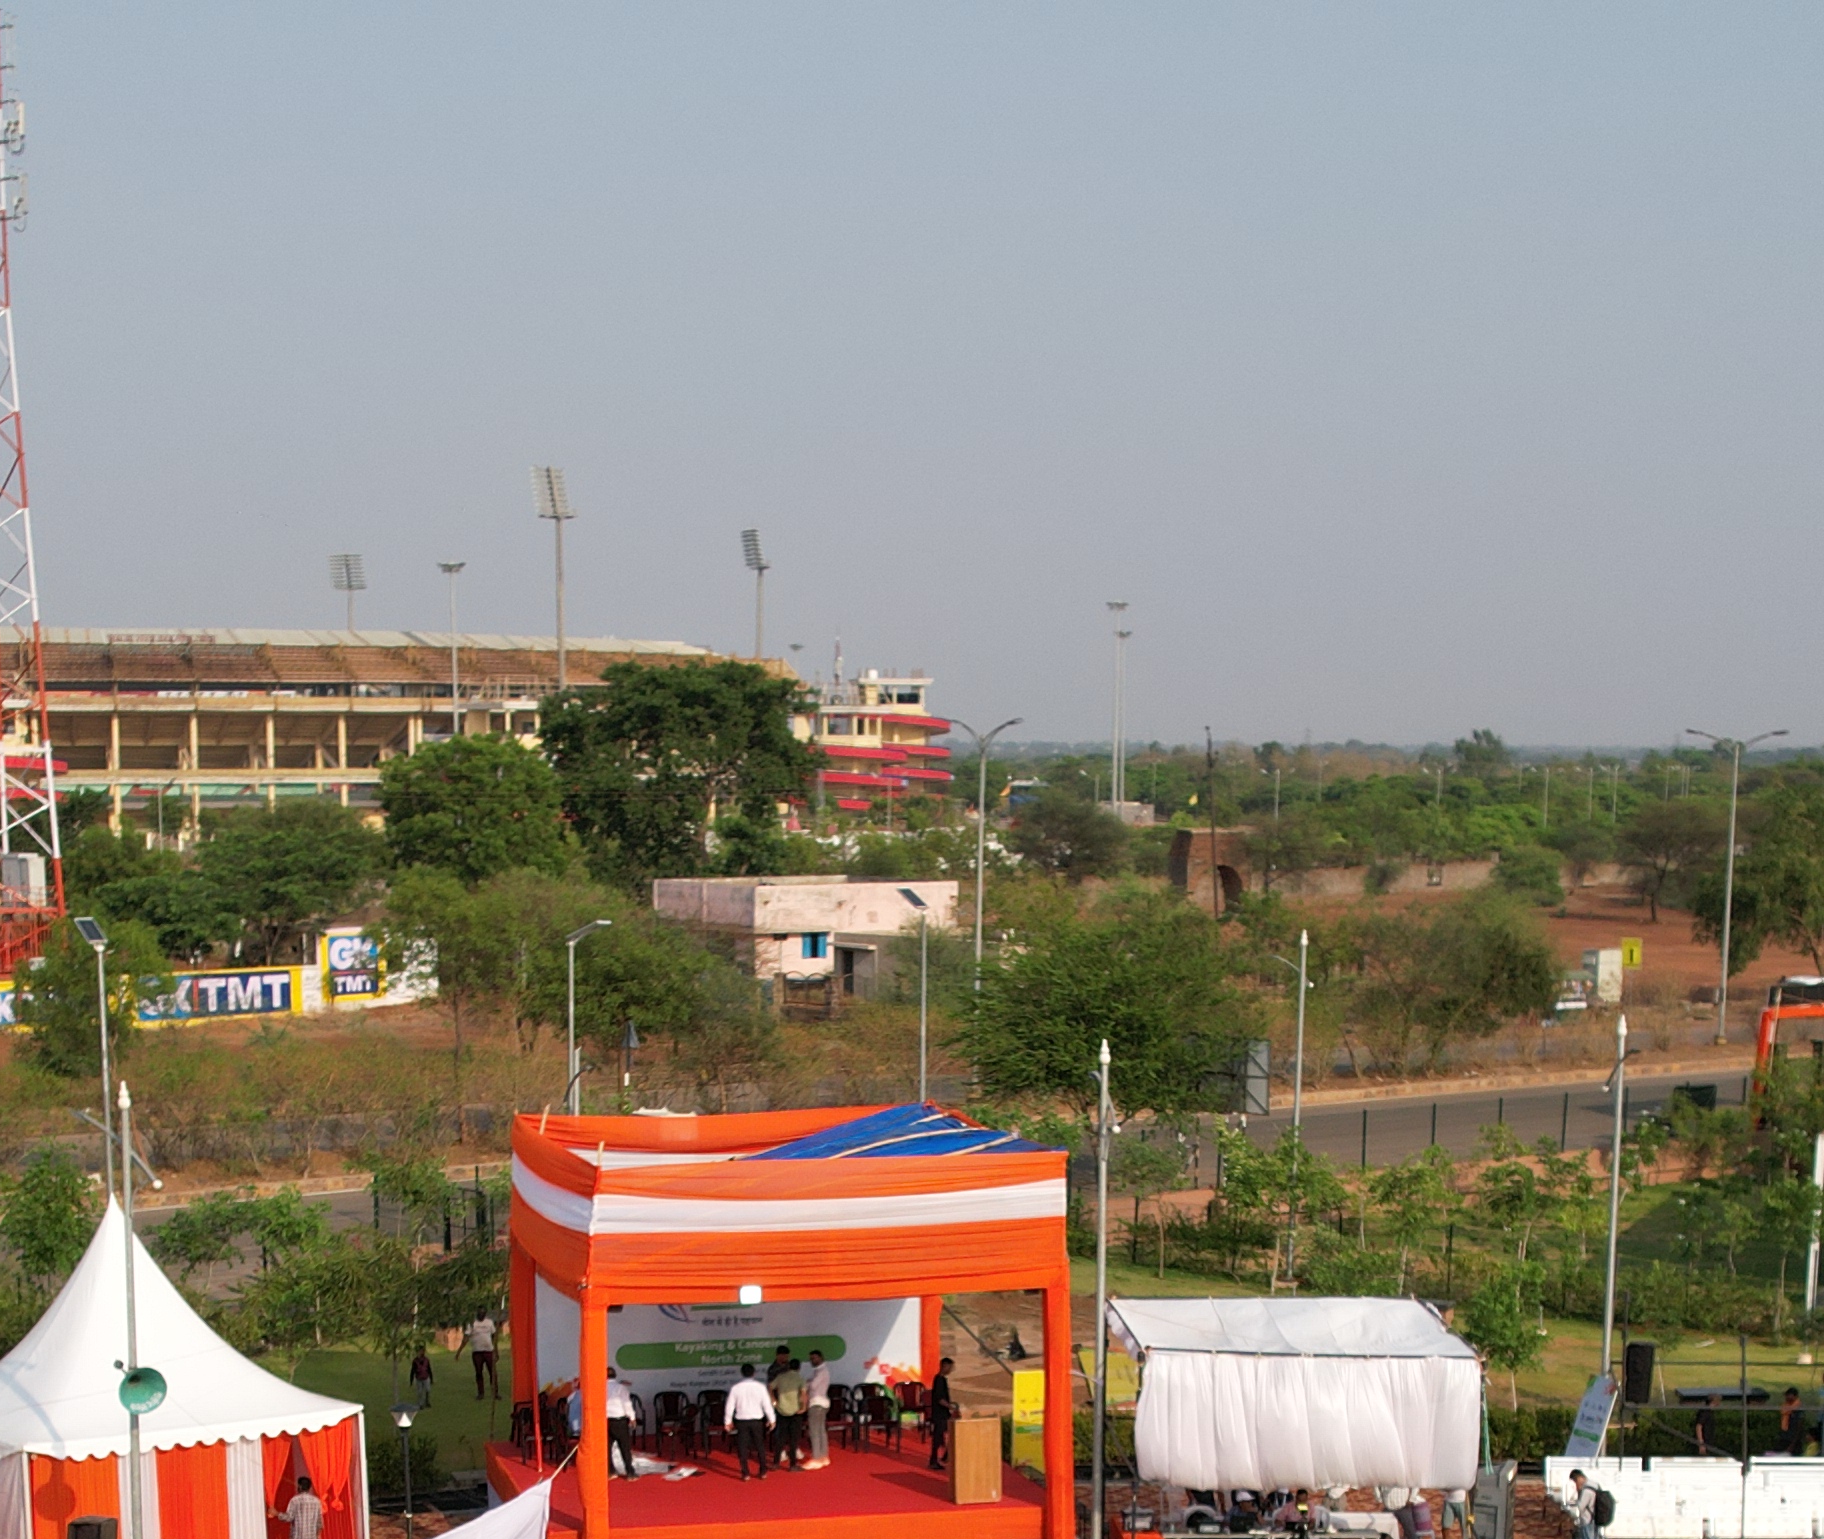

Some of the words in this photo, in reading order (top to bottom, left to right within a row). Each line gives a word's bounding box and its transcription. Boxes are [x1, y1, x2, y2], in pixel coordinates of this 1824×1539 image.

[330, 937, 376, 970] GK
[200, 973, 288, 1012] TMT
[334, 974, 372, 993] TMT
[674, 1342, 725, 1354] Kayaking
[727, 1340, 736, 1350] &
[701, 1354, 734, 1364] North
[735, 1353, 763, 1363] Zone
